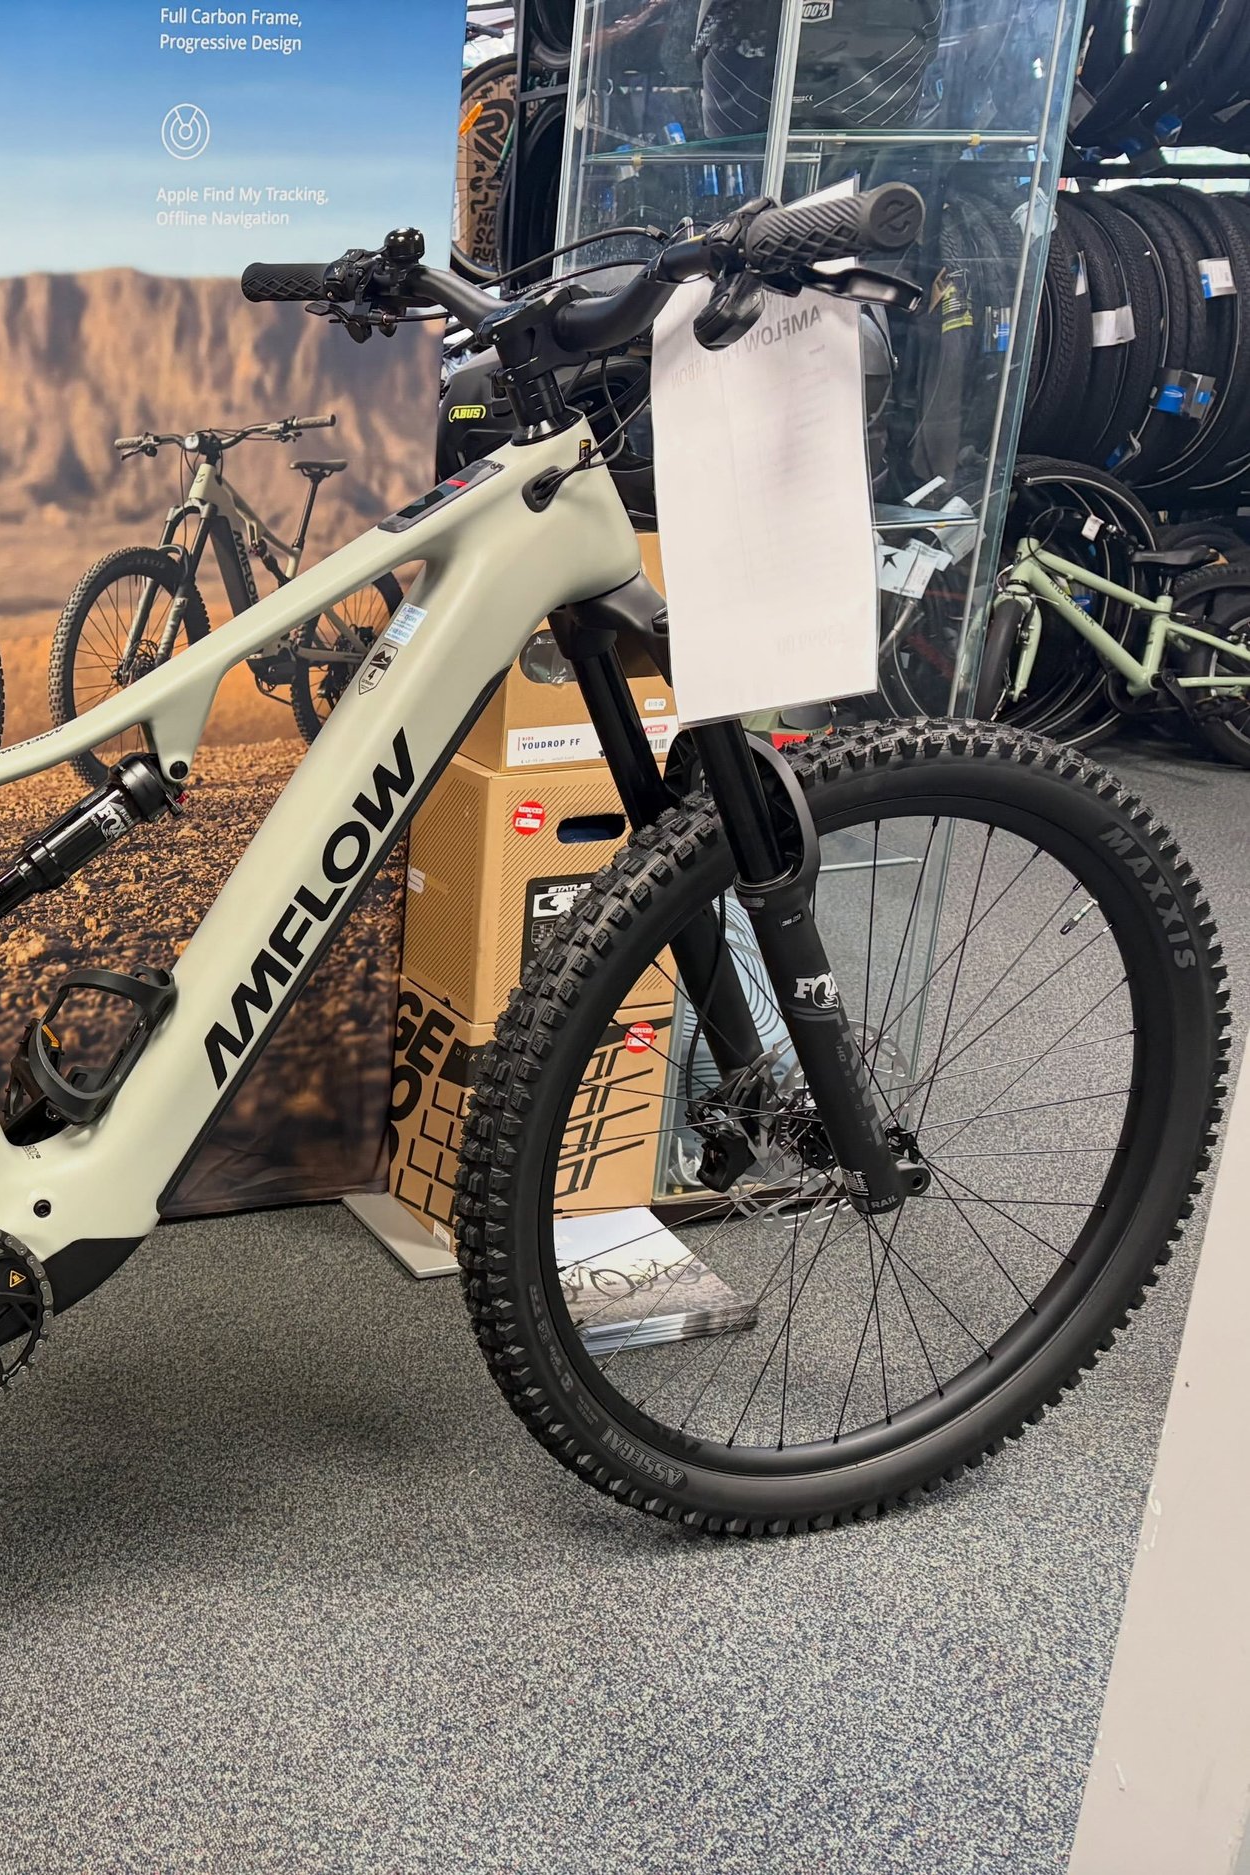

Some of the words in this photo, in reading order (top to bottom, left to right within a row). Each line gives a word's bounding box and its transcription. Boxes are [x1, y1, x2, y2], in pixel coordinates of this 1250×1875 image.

[160, 8, 186, 23] Full
[191, 9, 246, 24] Carbon
[251, 10, 302, 27] Frame,
[160, 34, 247, 53] Progressive
[251, 35, 302, 54] Design
[156, 188, 199, 206] Apple
[204, 188, 235, 202] Find
[240, 188, 262, 207] My
[265, 188, 329, 206] Tracking,
[156, 212, 207, 226] Offline
[212, 211, 289, 228] Navigation
[452, 408, 481, 419] ABUS
[522, 739, 566, 751] YOUDROP
[569, 738, 581, 747] FF
[98, 804, 128, 842] FOX
[548, 883, 592, 894] STATUS
[1098, 826, 1198, 969] MAXXIS
[204, 726, 416, 1091] AMFLOW
[794, 971, 840, 1009] FOX
[601, 1426, 687, 1488] ASSEGAI
